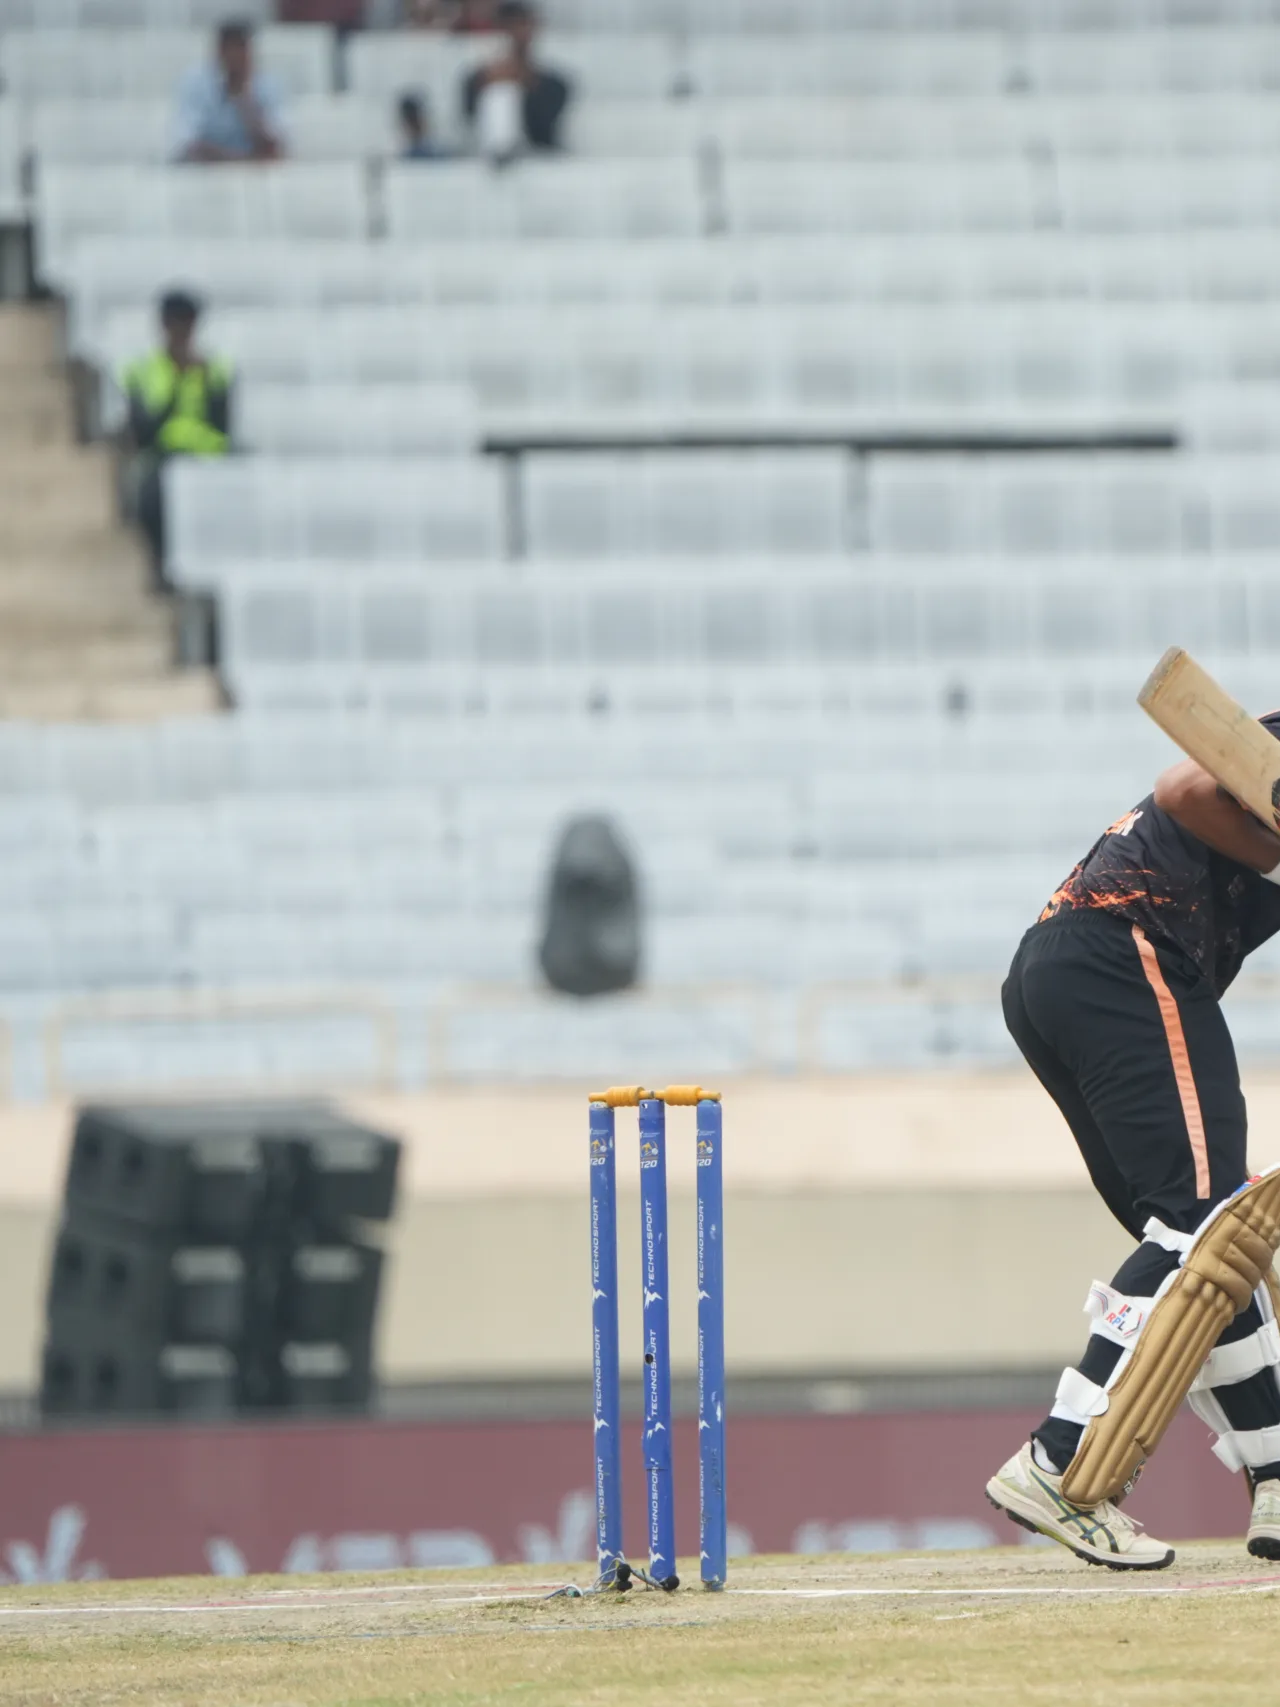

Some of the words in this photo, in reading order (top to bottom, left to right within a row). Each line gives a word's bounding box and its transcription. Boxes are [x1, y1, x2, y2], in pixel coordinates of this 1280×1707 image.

[592, 1197, 600, 1284] TECHNOSPORT
[645, 1200, 655, 1287] TECHNOSPORT
[1106, 1312, 1125, 1331] RPL
[594, 1326, 602, 1414] TECHNOSPORT
